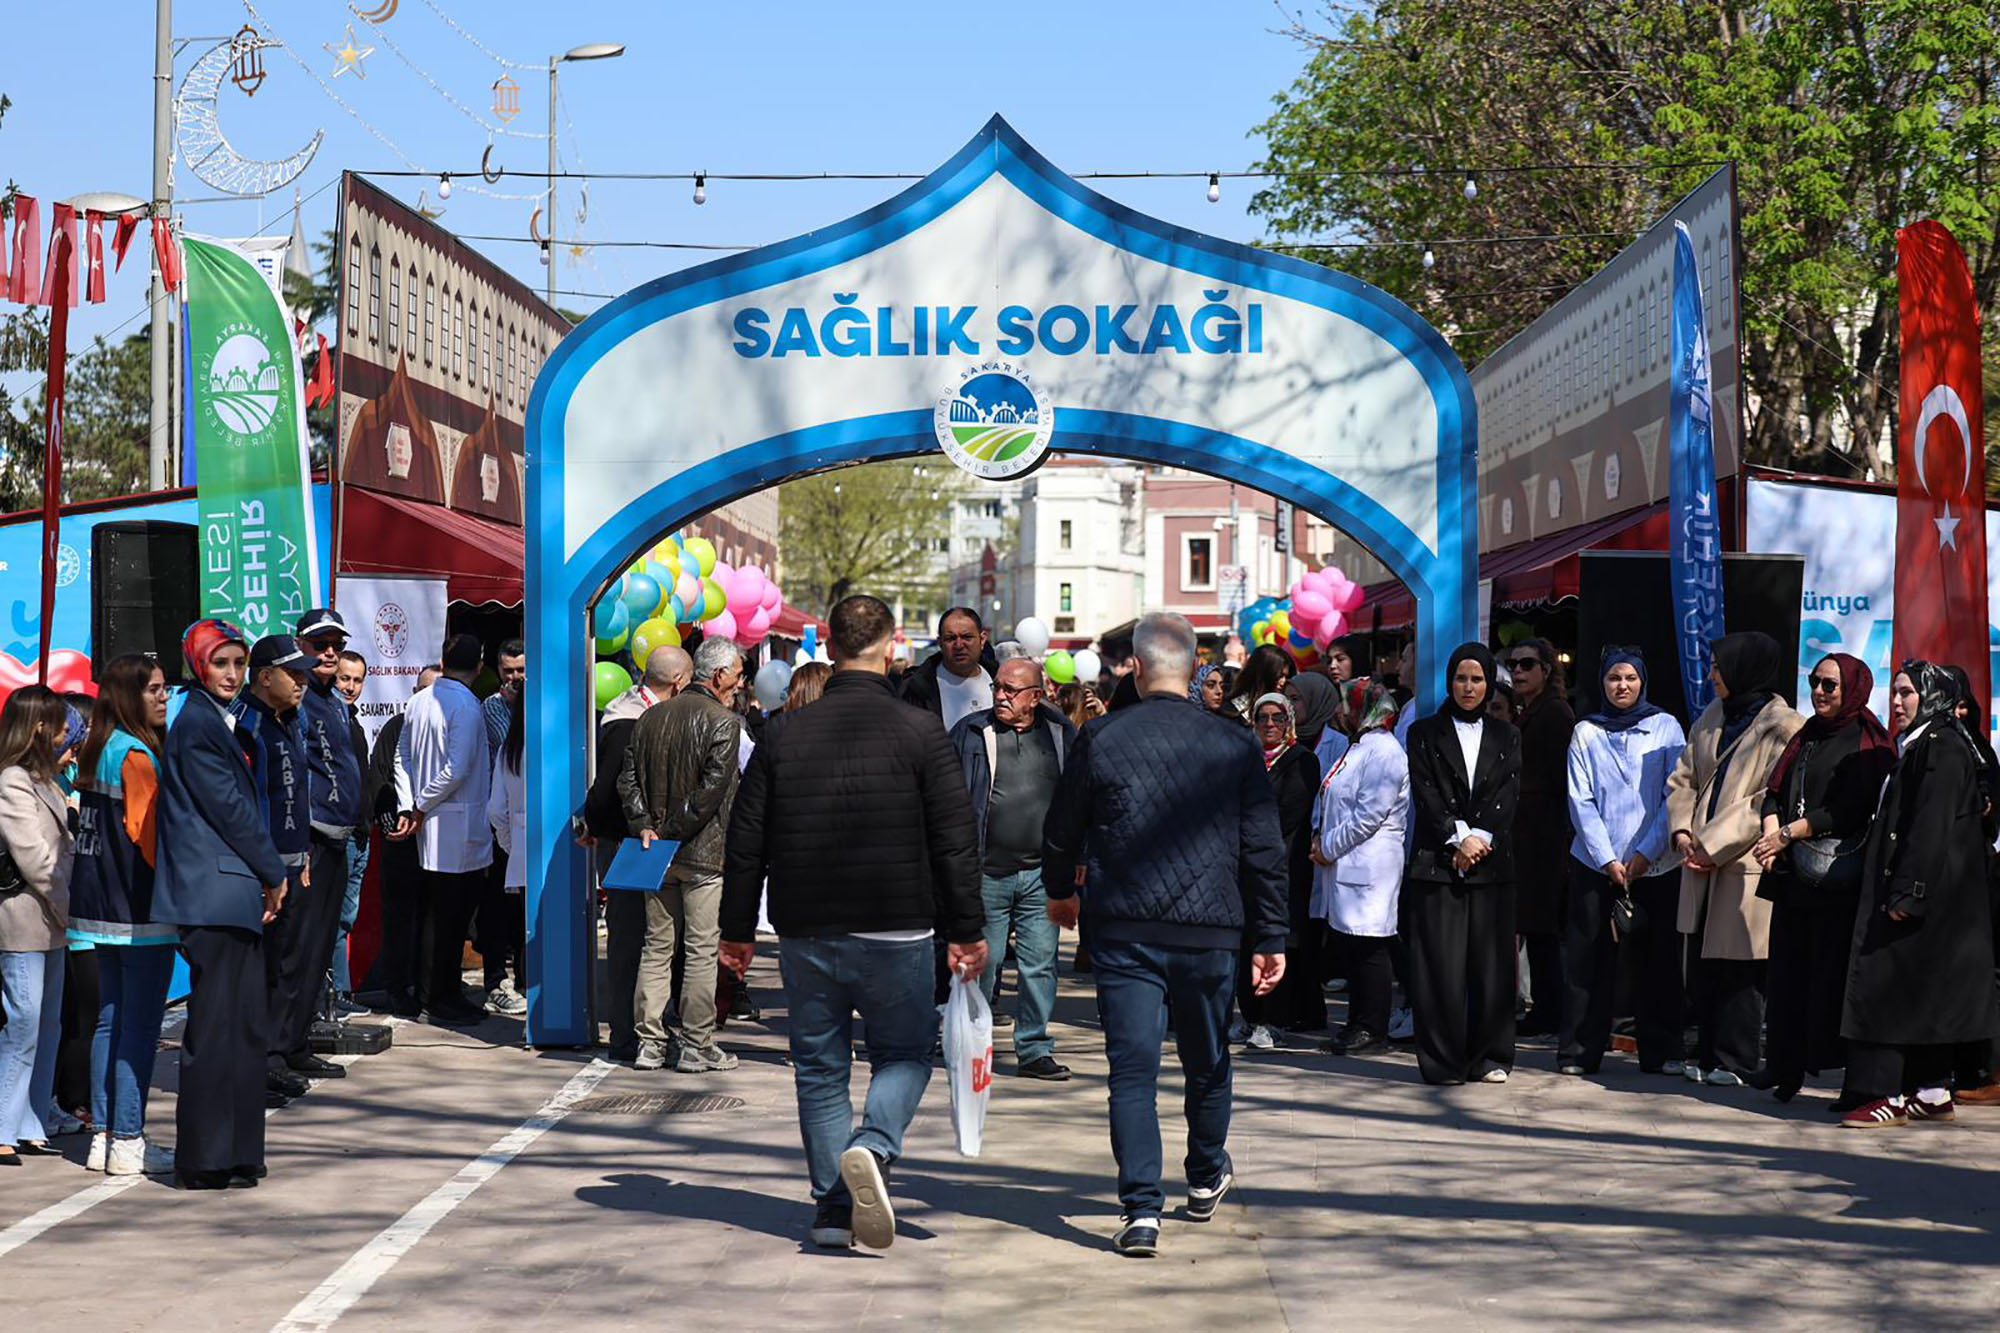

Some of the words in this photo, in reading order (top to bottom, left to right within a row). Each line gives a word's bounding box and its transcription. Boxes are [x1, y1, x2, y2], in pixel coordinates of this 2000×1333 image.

[733, 292, 980, 359] SAĞLIK
[996, 289, 1263, 358] SOKAĞI
[960, 362, 1031, 383] SAKARYA
[1803, 591, 1870, 616] ünya
[367, 665, 393, 677] SAĞLIK
[360, 702, 396, 717] SAKARYA
[315, 720, 340, 803] ZABITA
[275, 741, 297, 830] ZABITA
